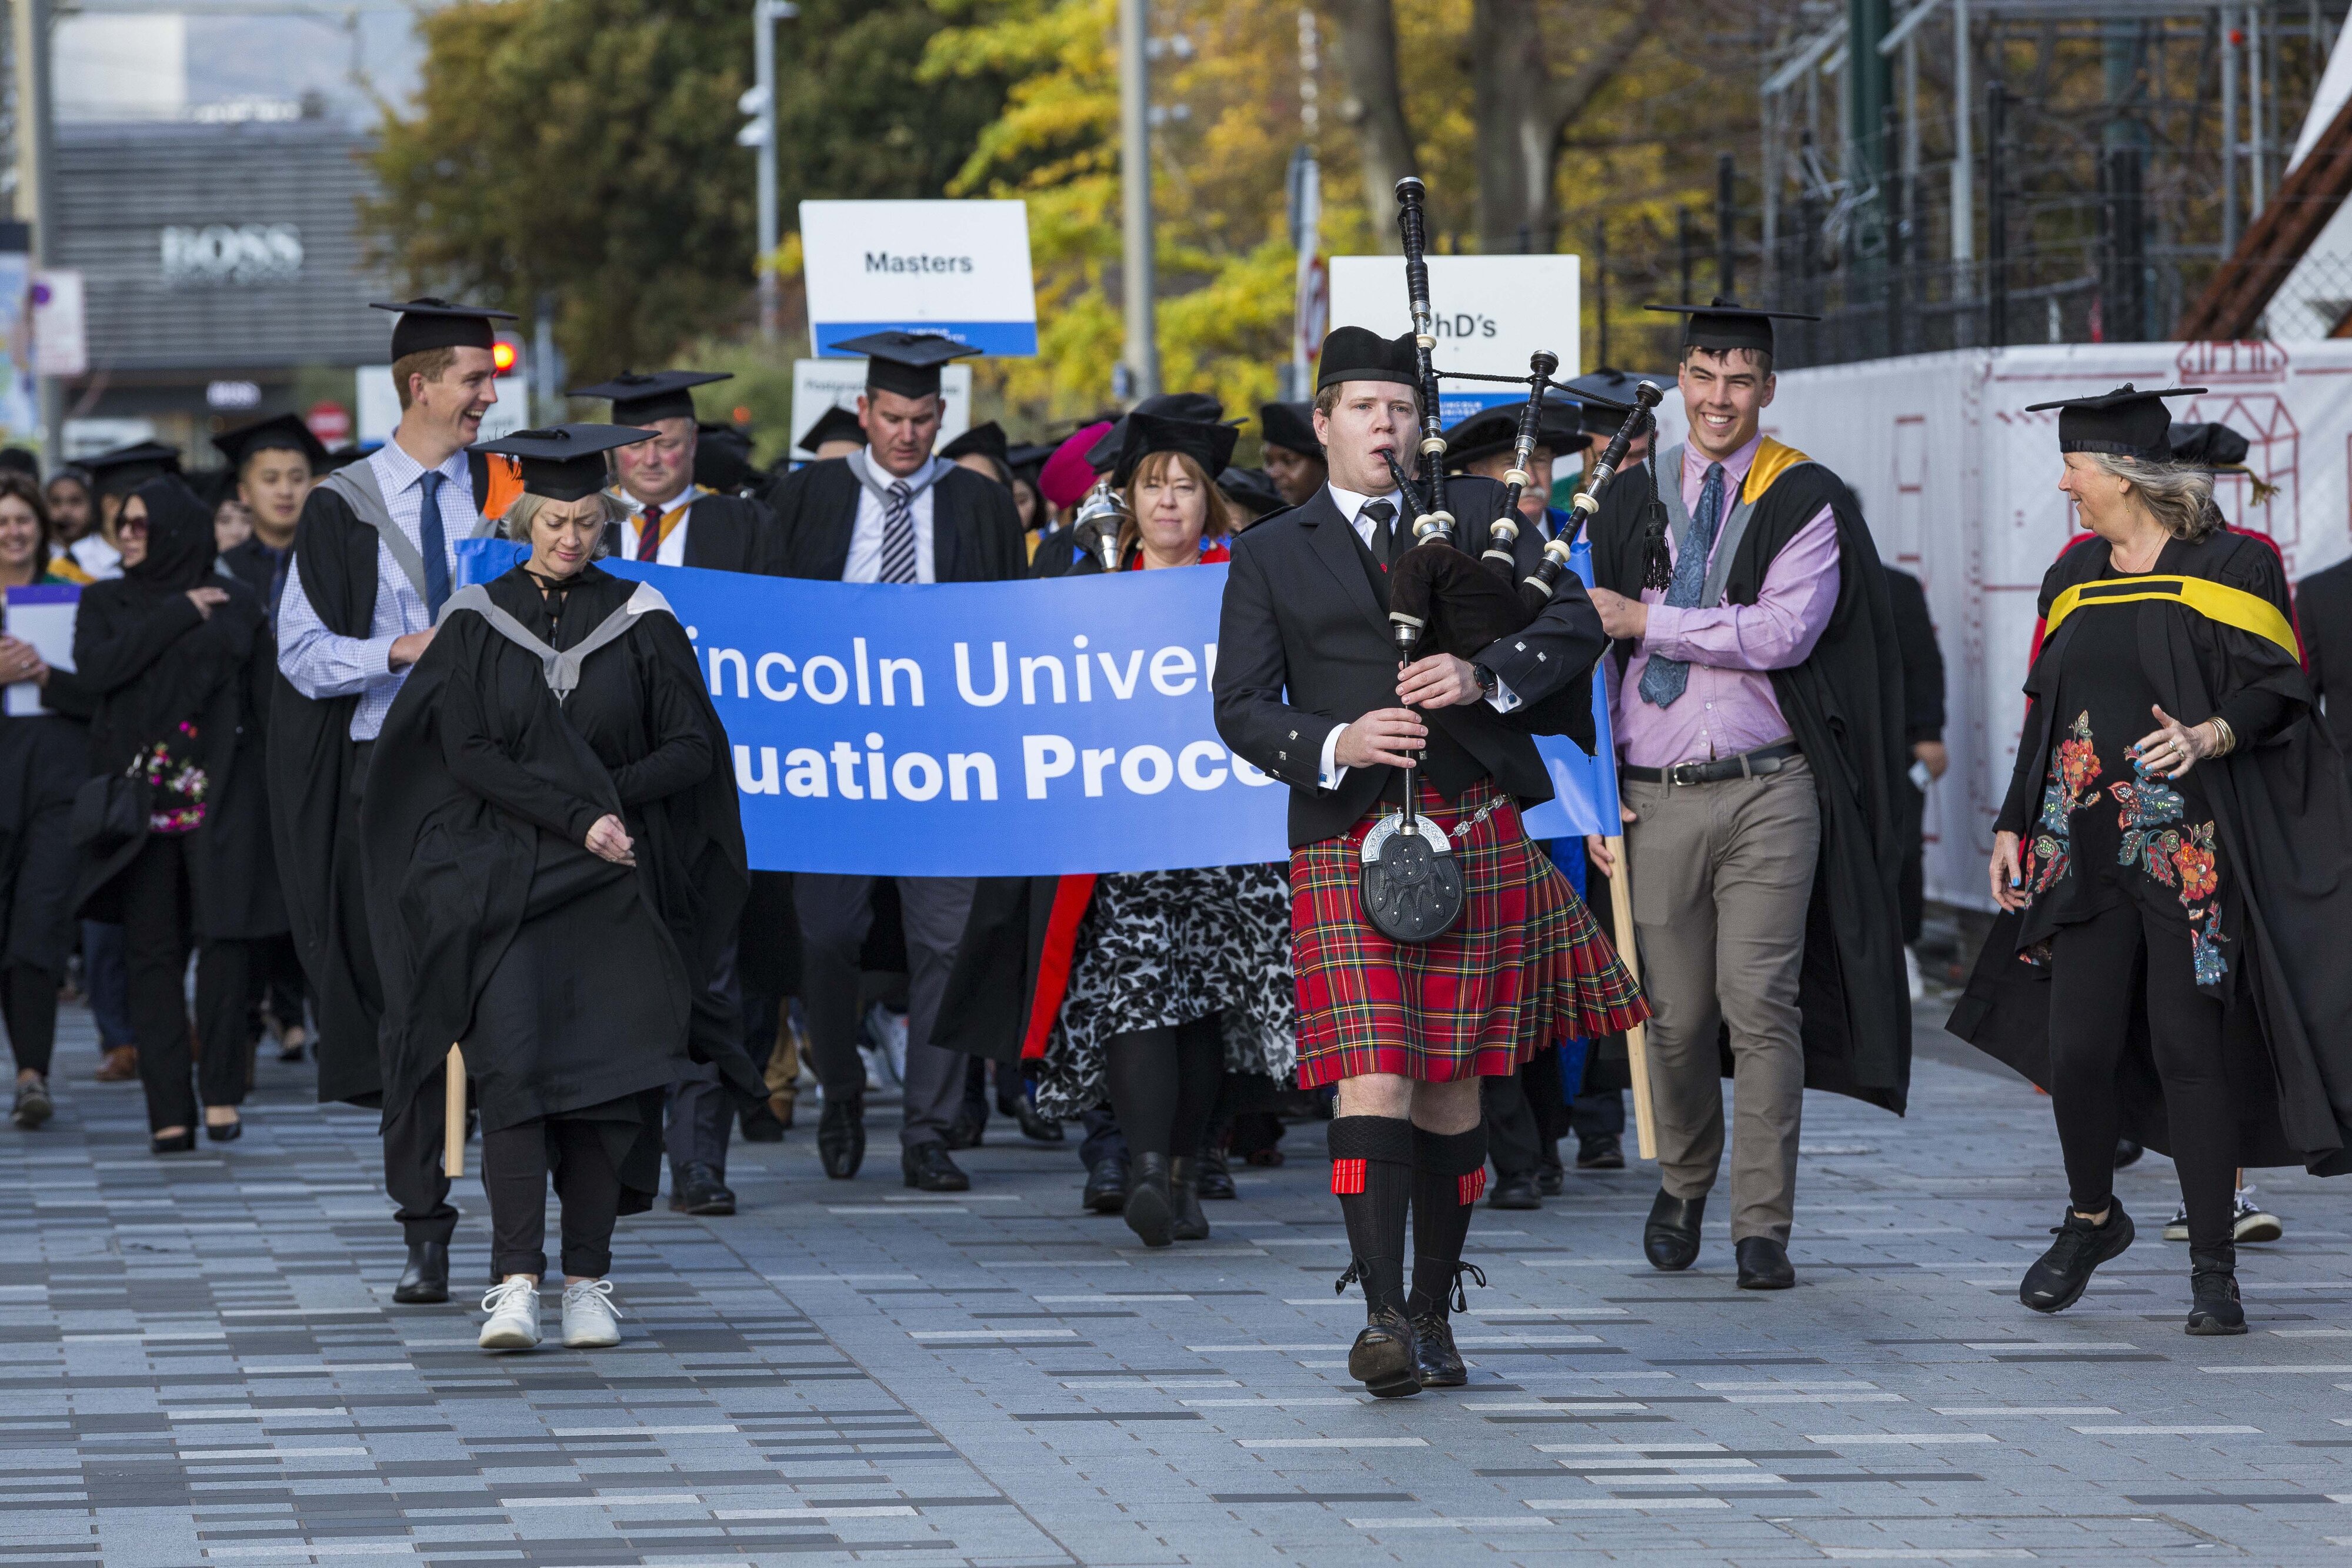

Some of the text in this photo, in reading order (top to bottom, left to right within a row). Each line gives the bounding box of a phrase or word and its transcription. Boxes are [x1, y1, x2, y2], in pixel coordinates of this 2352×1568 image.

[865, 252, 973, 273] Masters
[686, 625, 924, 706] ncoln
[733, 732, 998, 801] uation
